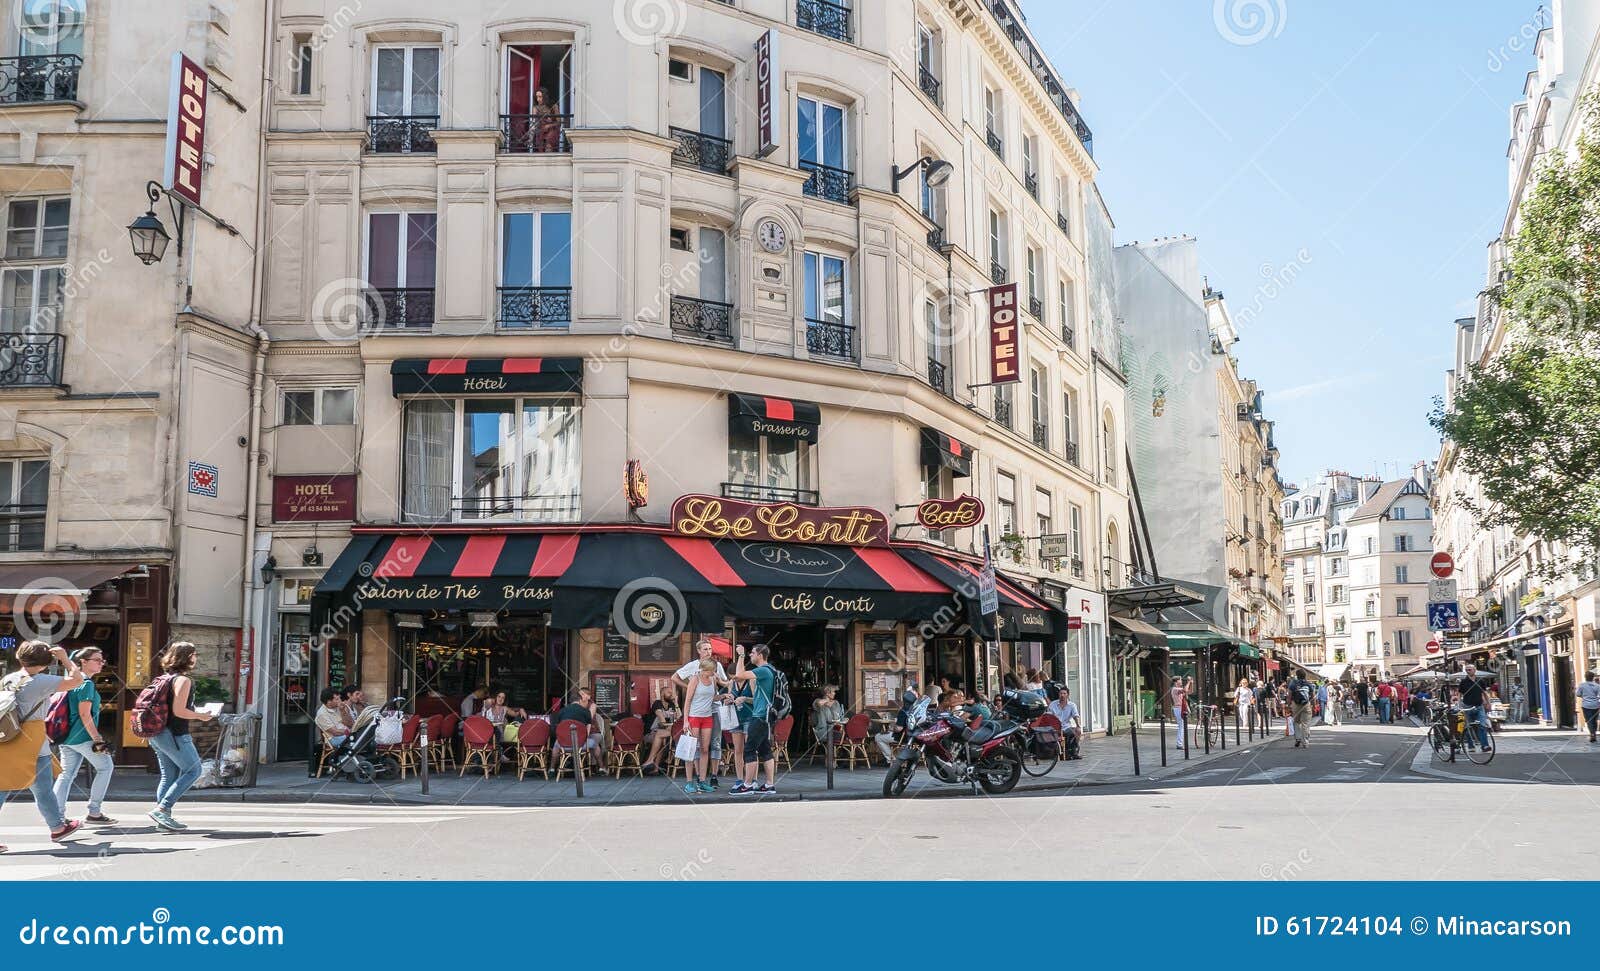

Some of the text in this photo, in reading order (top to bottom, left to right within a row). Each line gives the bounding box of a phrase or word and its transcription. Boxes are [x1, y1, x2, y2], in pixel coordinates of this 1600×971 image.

[758, 34, 770, 151] HOTEL
[179, 66, 204, 194] HOTEL
[993, 290, 1015, 377] HOTEL
[463, 376, 507, 390] Hôtel
[752, 420, 810, 437] Brasserie
[295, 485, 334, 495] HOTEL
[678, 499, 884, 545] Le Conti
[920, 502, 977, 525] Café
[308, 554, 317, 565] 2
[359, 584, 413, 600] Salon
[411, 584, 440, 599] de
[444, 584, 481, 599] Thé
[771, 592, 875, 614] Café Conti
